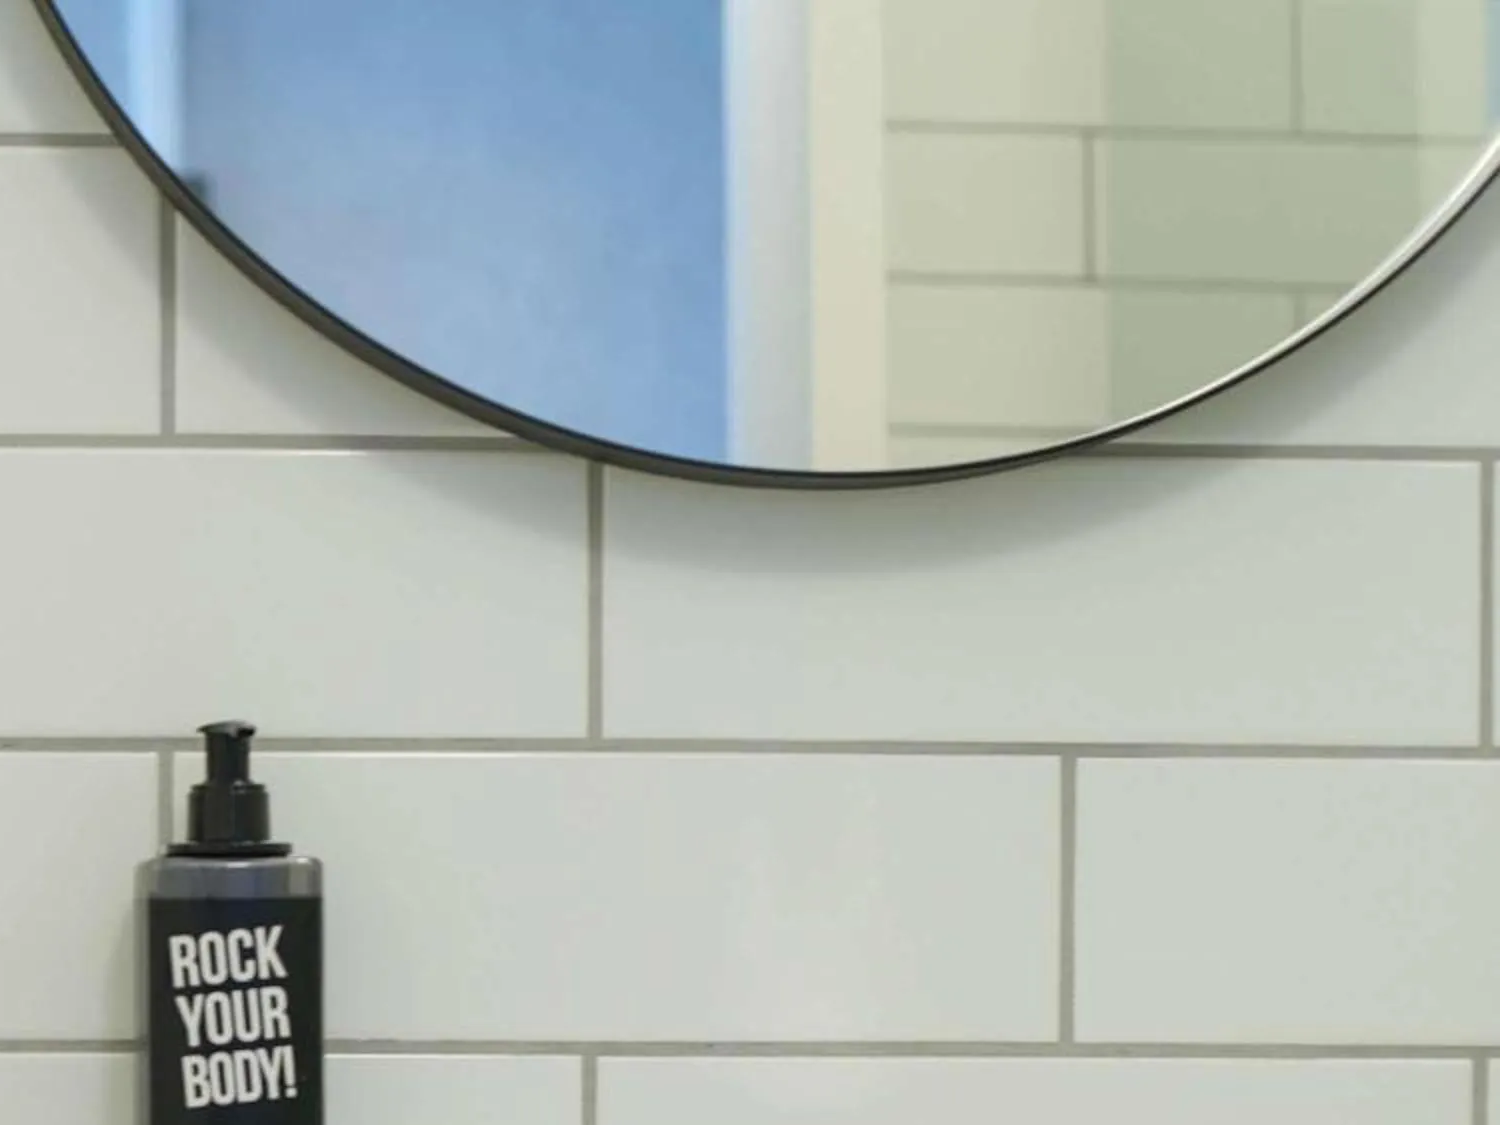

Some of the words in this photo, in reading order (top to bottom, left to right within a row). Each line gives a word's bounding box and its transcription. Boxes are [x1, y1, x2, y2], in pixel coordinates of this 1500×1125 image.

[169, 925, 288, 988] ROCK
[175, 986, 292, 1047] YOUR
[181, 1046, 298, 1108] BODY!
